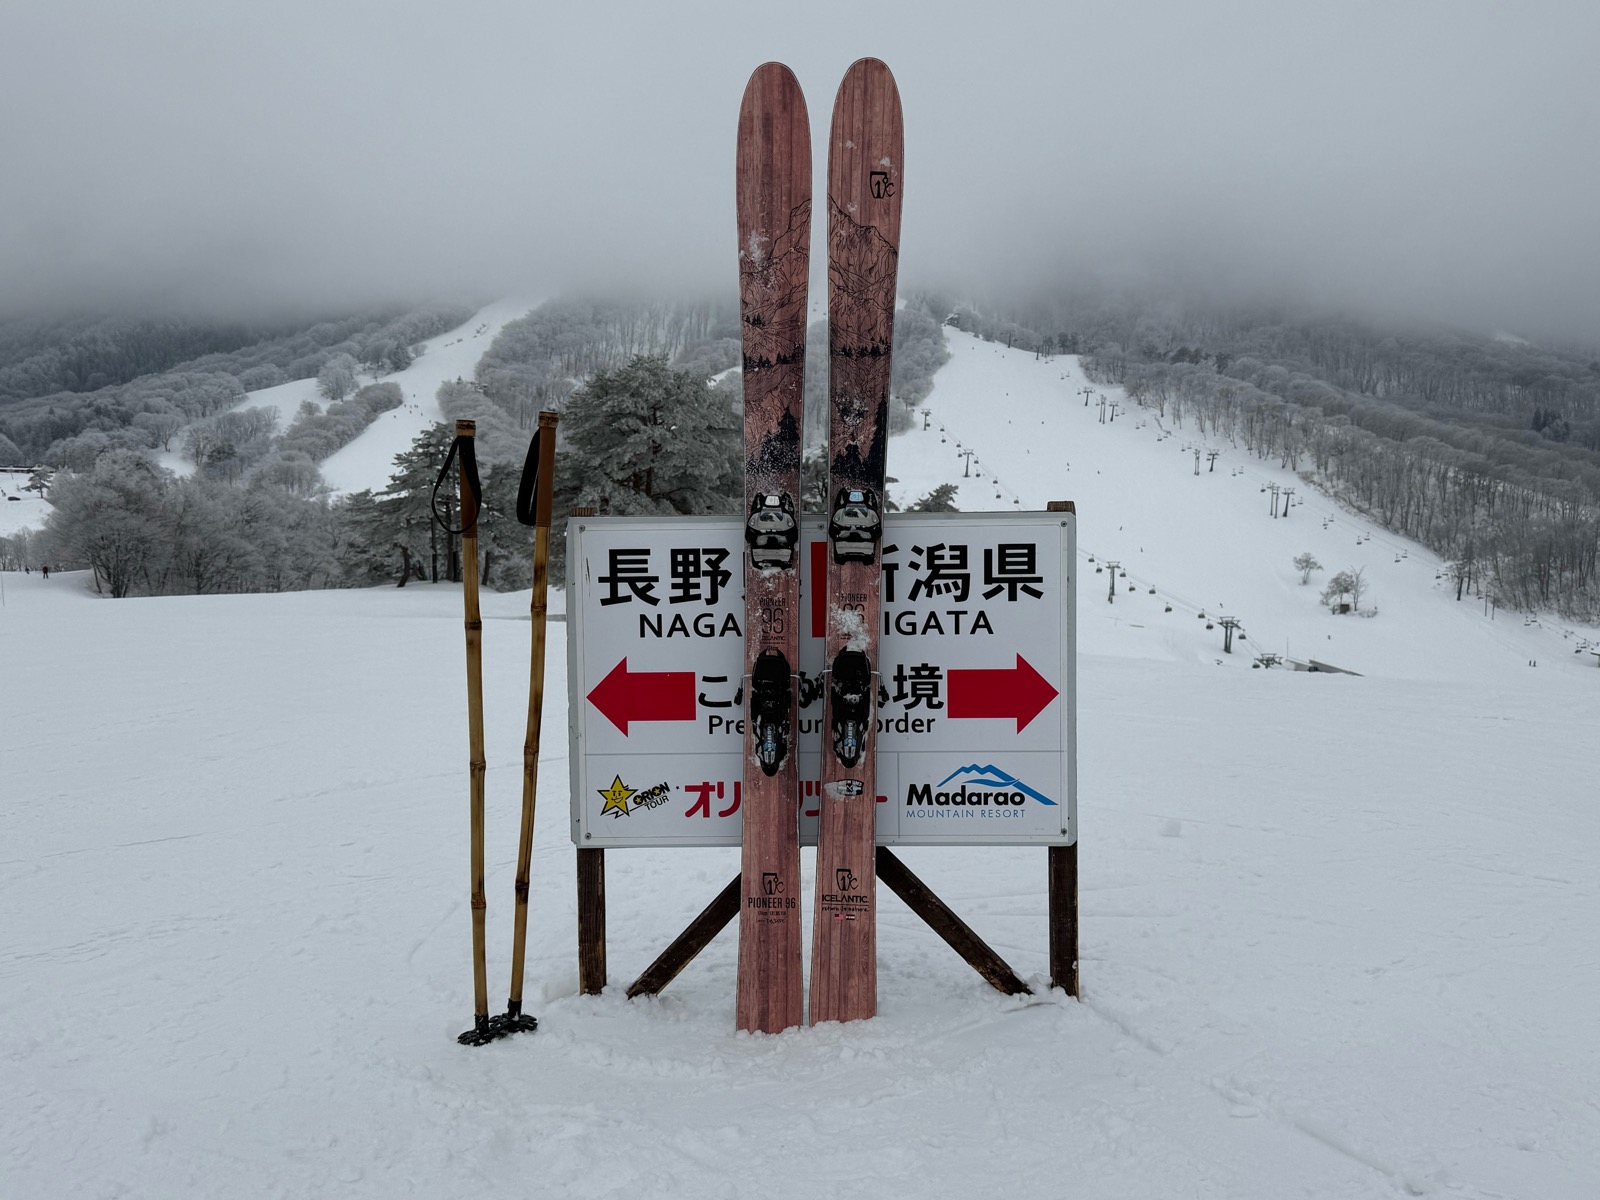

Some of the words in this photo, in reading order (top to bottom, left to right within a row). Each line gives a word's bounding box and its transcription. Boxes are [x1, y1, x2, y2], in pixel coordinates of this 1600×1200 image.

[598, 548, 745, 607] 長野
[640, 613, 743, 638] NAGA
[761, 607, 784, 634] 96
[884, 610, 994, 635] IGATA
[633, 781, 671, 805] ORION
[644, 795, 670, 811] TOUR
[906, 784, 1026, 806] Madarao
[906, 809, 974, 818] MOUNTAIN
[981, 809, 1026, 818] RESORT
[747, 897, 783, 909] PIONEER
[785, 897, 796, 909] 96
[822, 894, 868, 903] ICELANTIC
